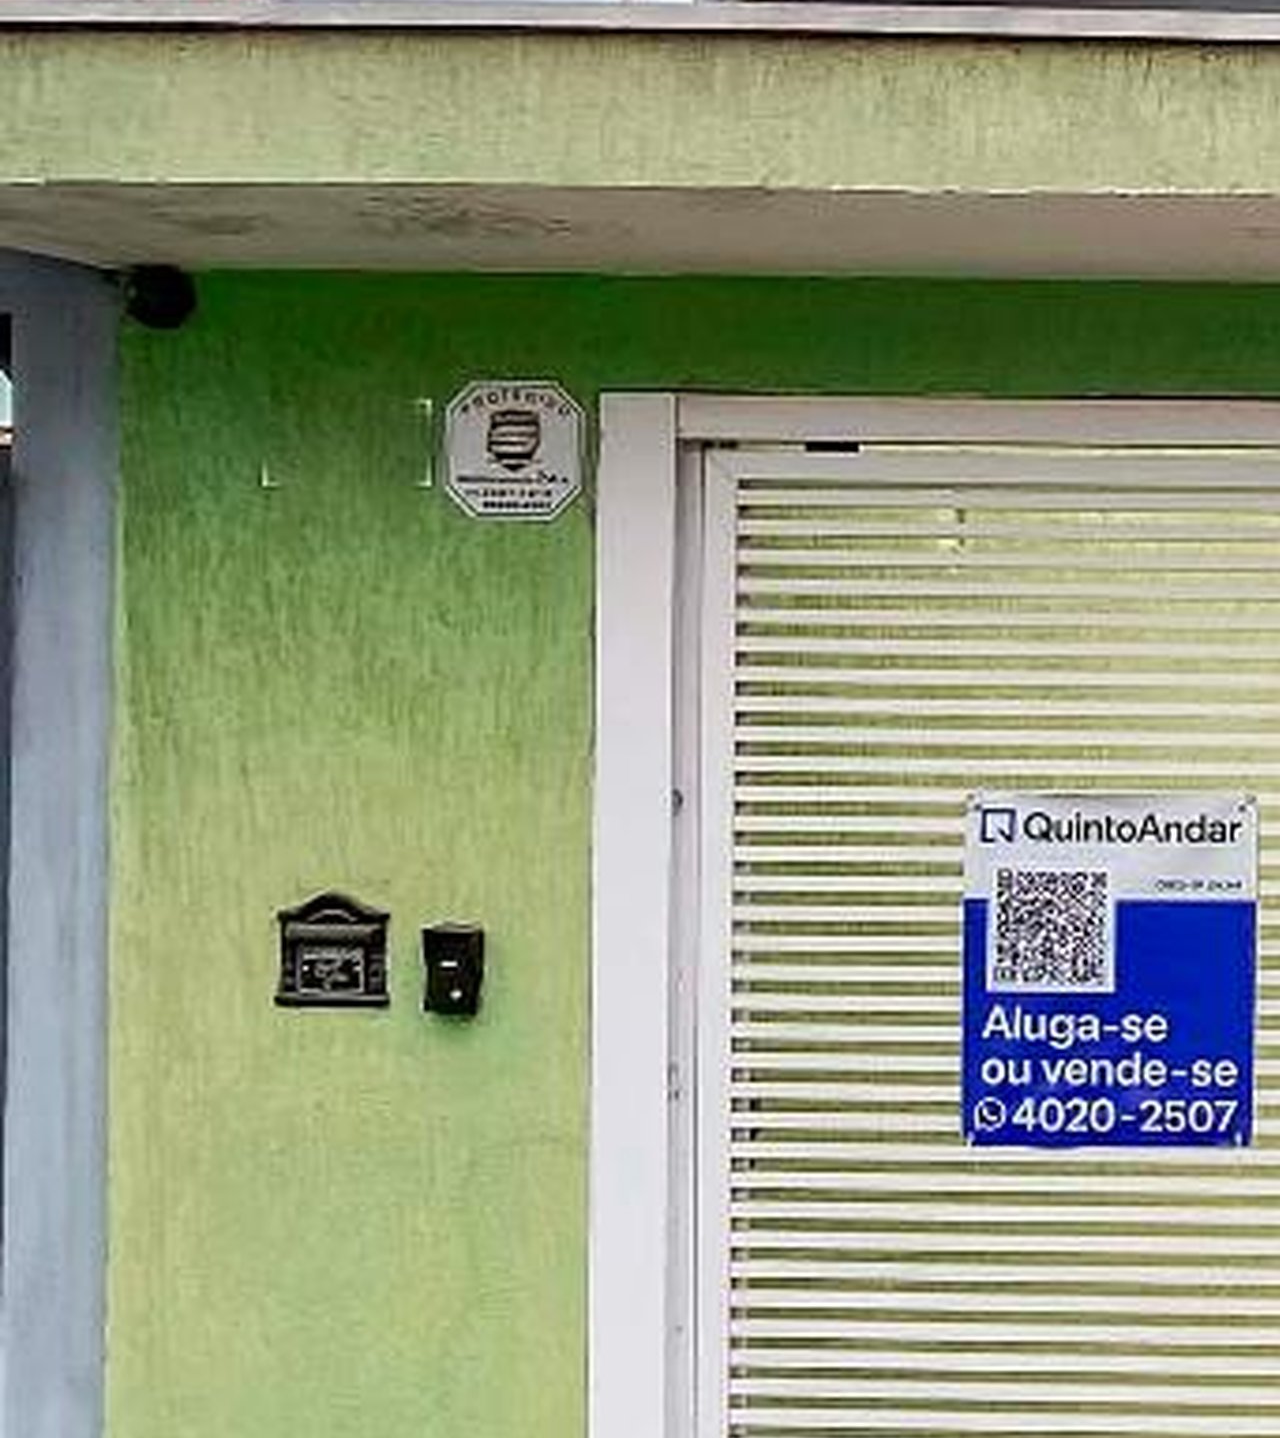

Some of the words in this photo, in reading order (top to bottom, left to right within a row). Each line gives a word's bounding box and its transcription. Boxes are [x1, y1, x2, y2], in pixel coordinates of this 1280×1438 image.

[1023, 812, 1242, 844] QuintoAndar
[982, 1006, 1168, 1048] Aluga-se
[981, 1057, 1030, 1086] ou
[1041, 1053, 1239, 1087] vende-se
[1011, 1098, 1239, 1133] 4020-2507
